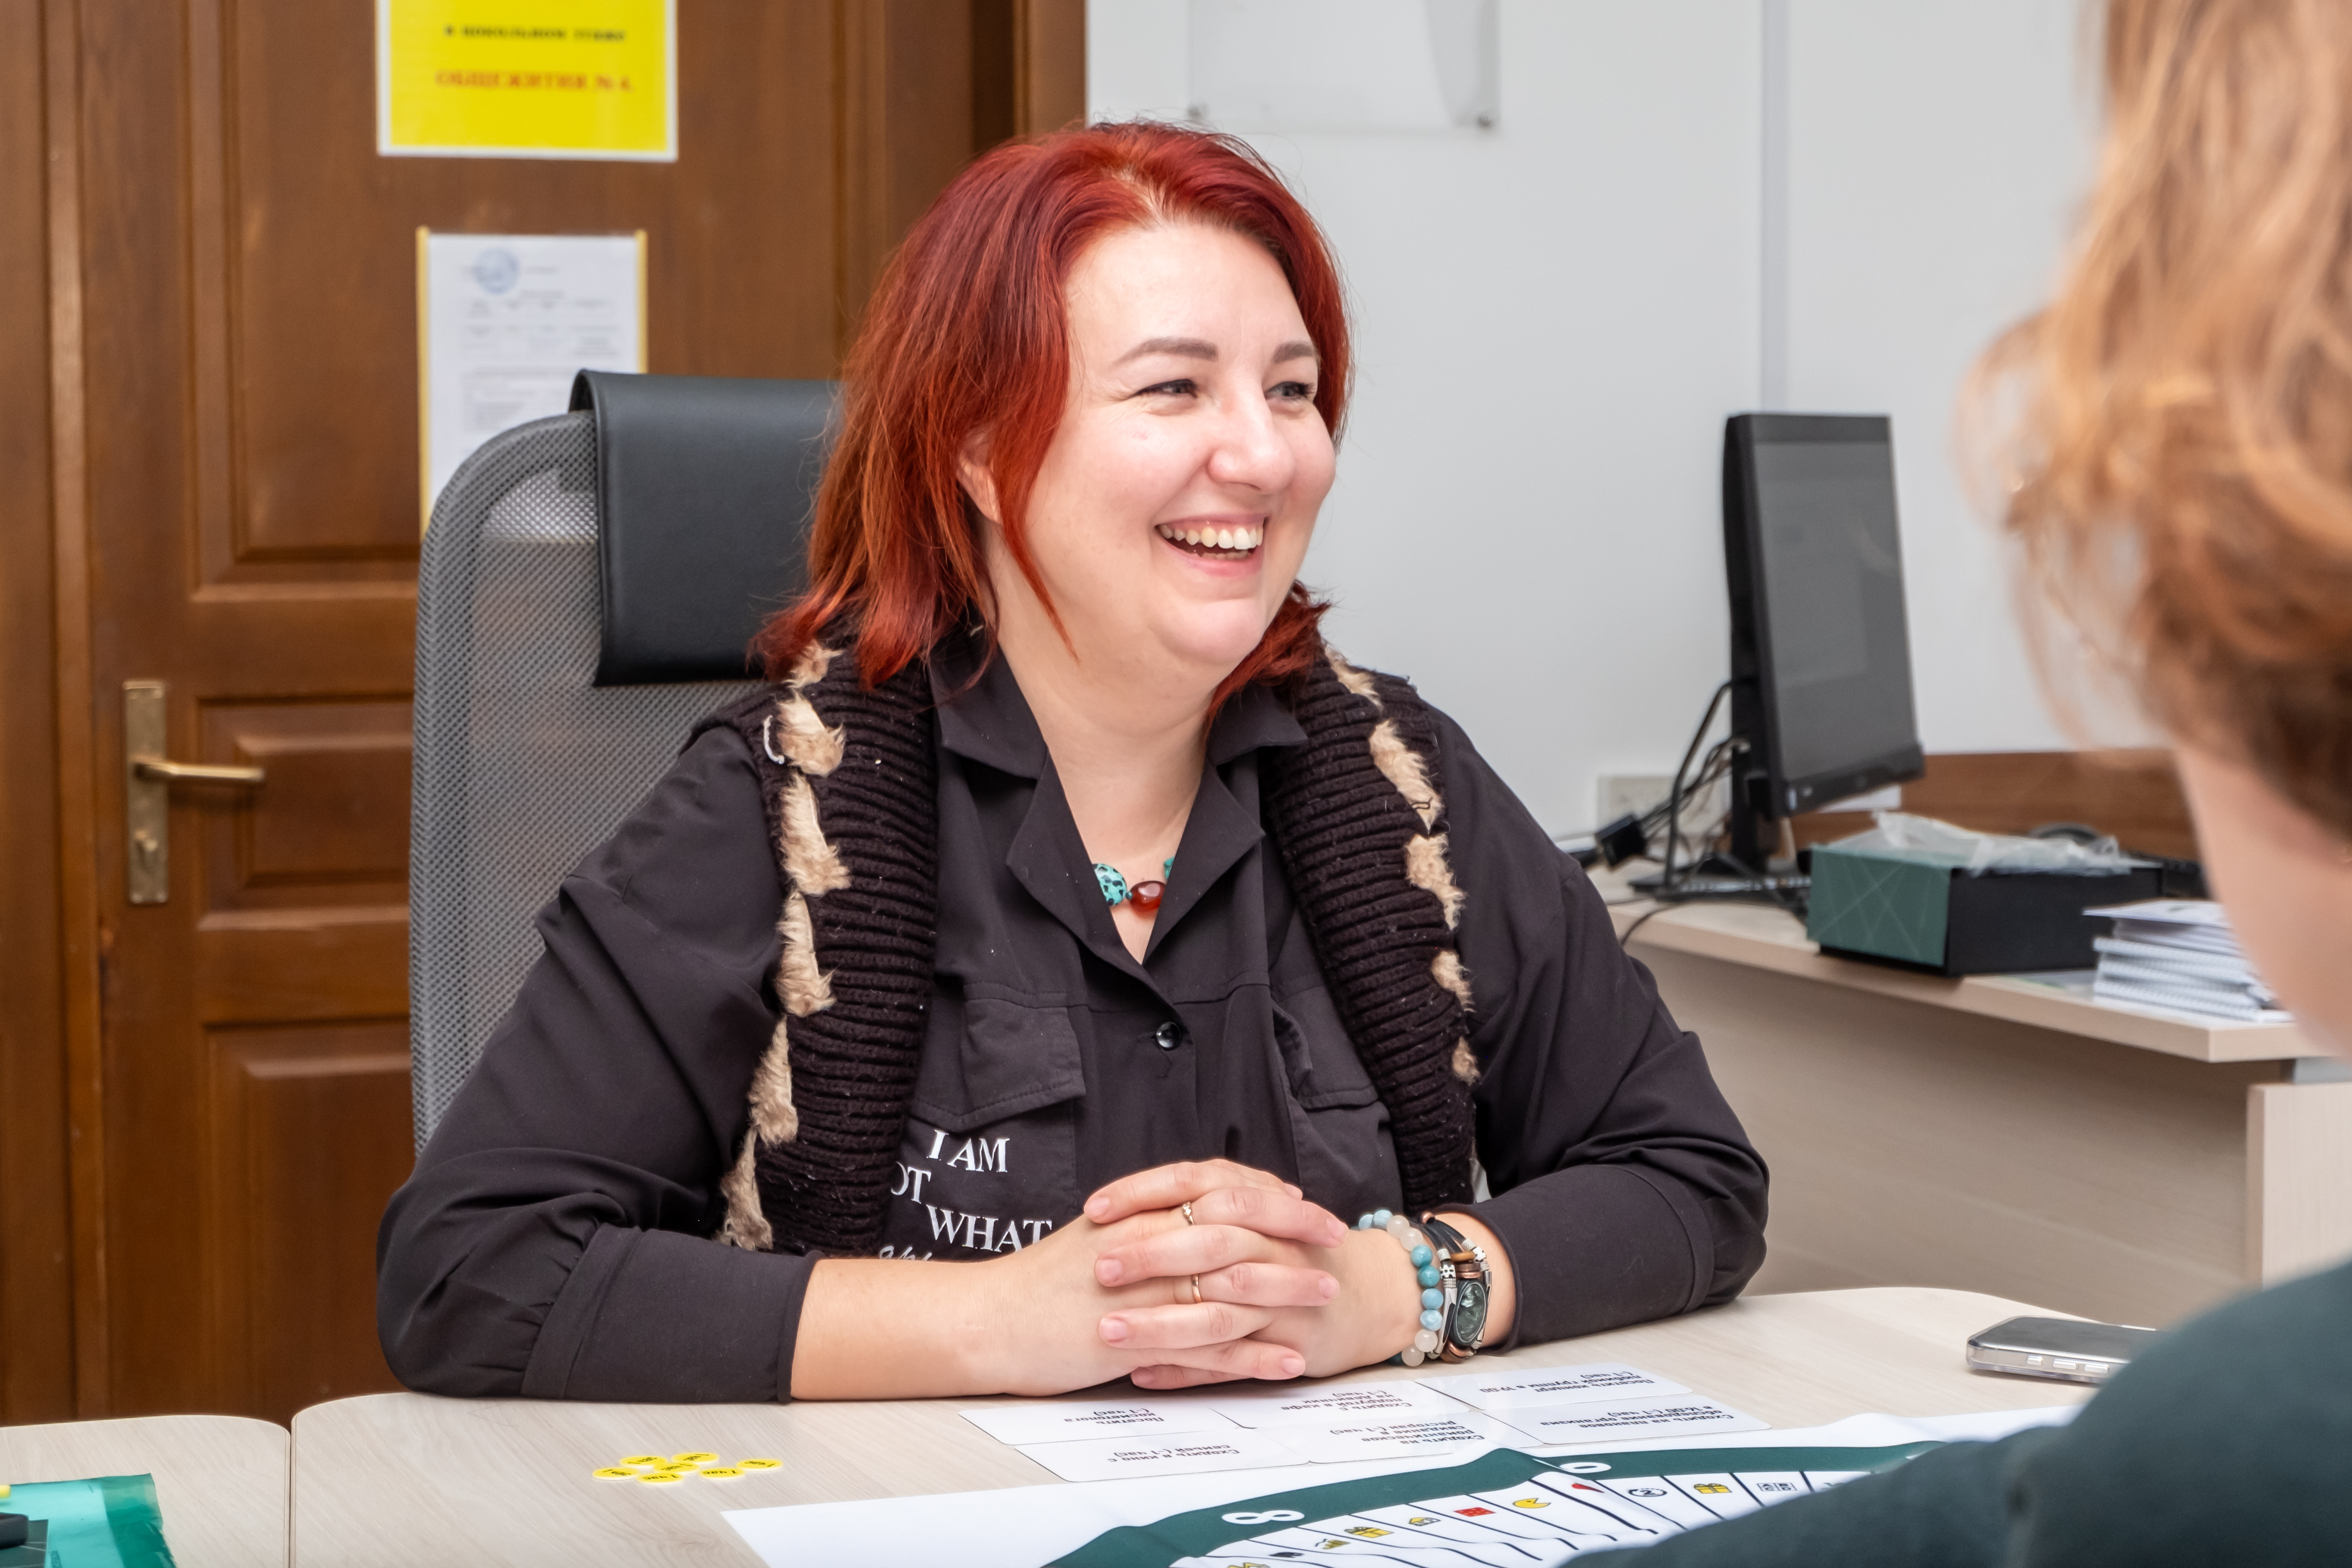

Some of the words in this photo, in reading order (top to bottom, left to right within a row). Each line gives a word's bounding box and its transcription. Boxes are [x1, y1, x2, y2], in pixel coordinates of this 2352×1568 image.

[926, 1129, 949, 1161] I
[947, 1138, 1010, 1173] AM
[926, 1204, 1052, 1252] WHAT
[1528, 1380, 1578, 1388] группы
[1621, 1410, 1722, 1420] обследование
[1389, 1421, 1456, 1430] ресторан
[1540, 1418, 1617, 1426] организма
[1394, 1426, 1465, 1434] свидание
[1361, 1430, 1475, 1442] романтическое
